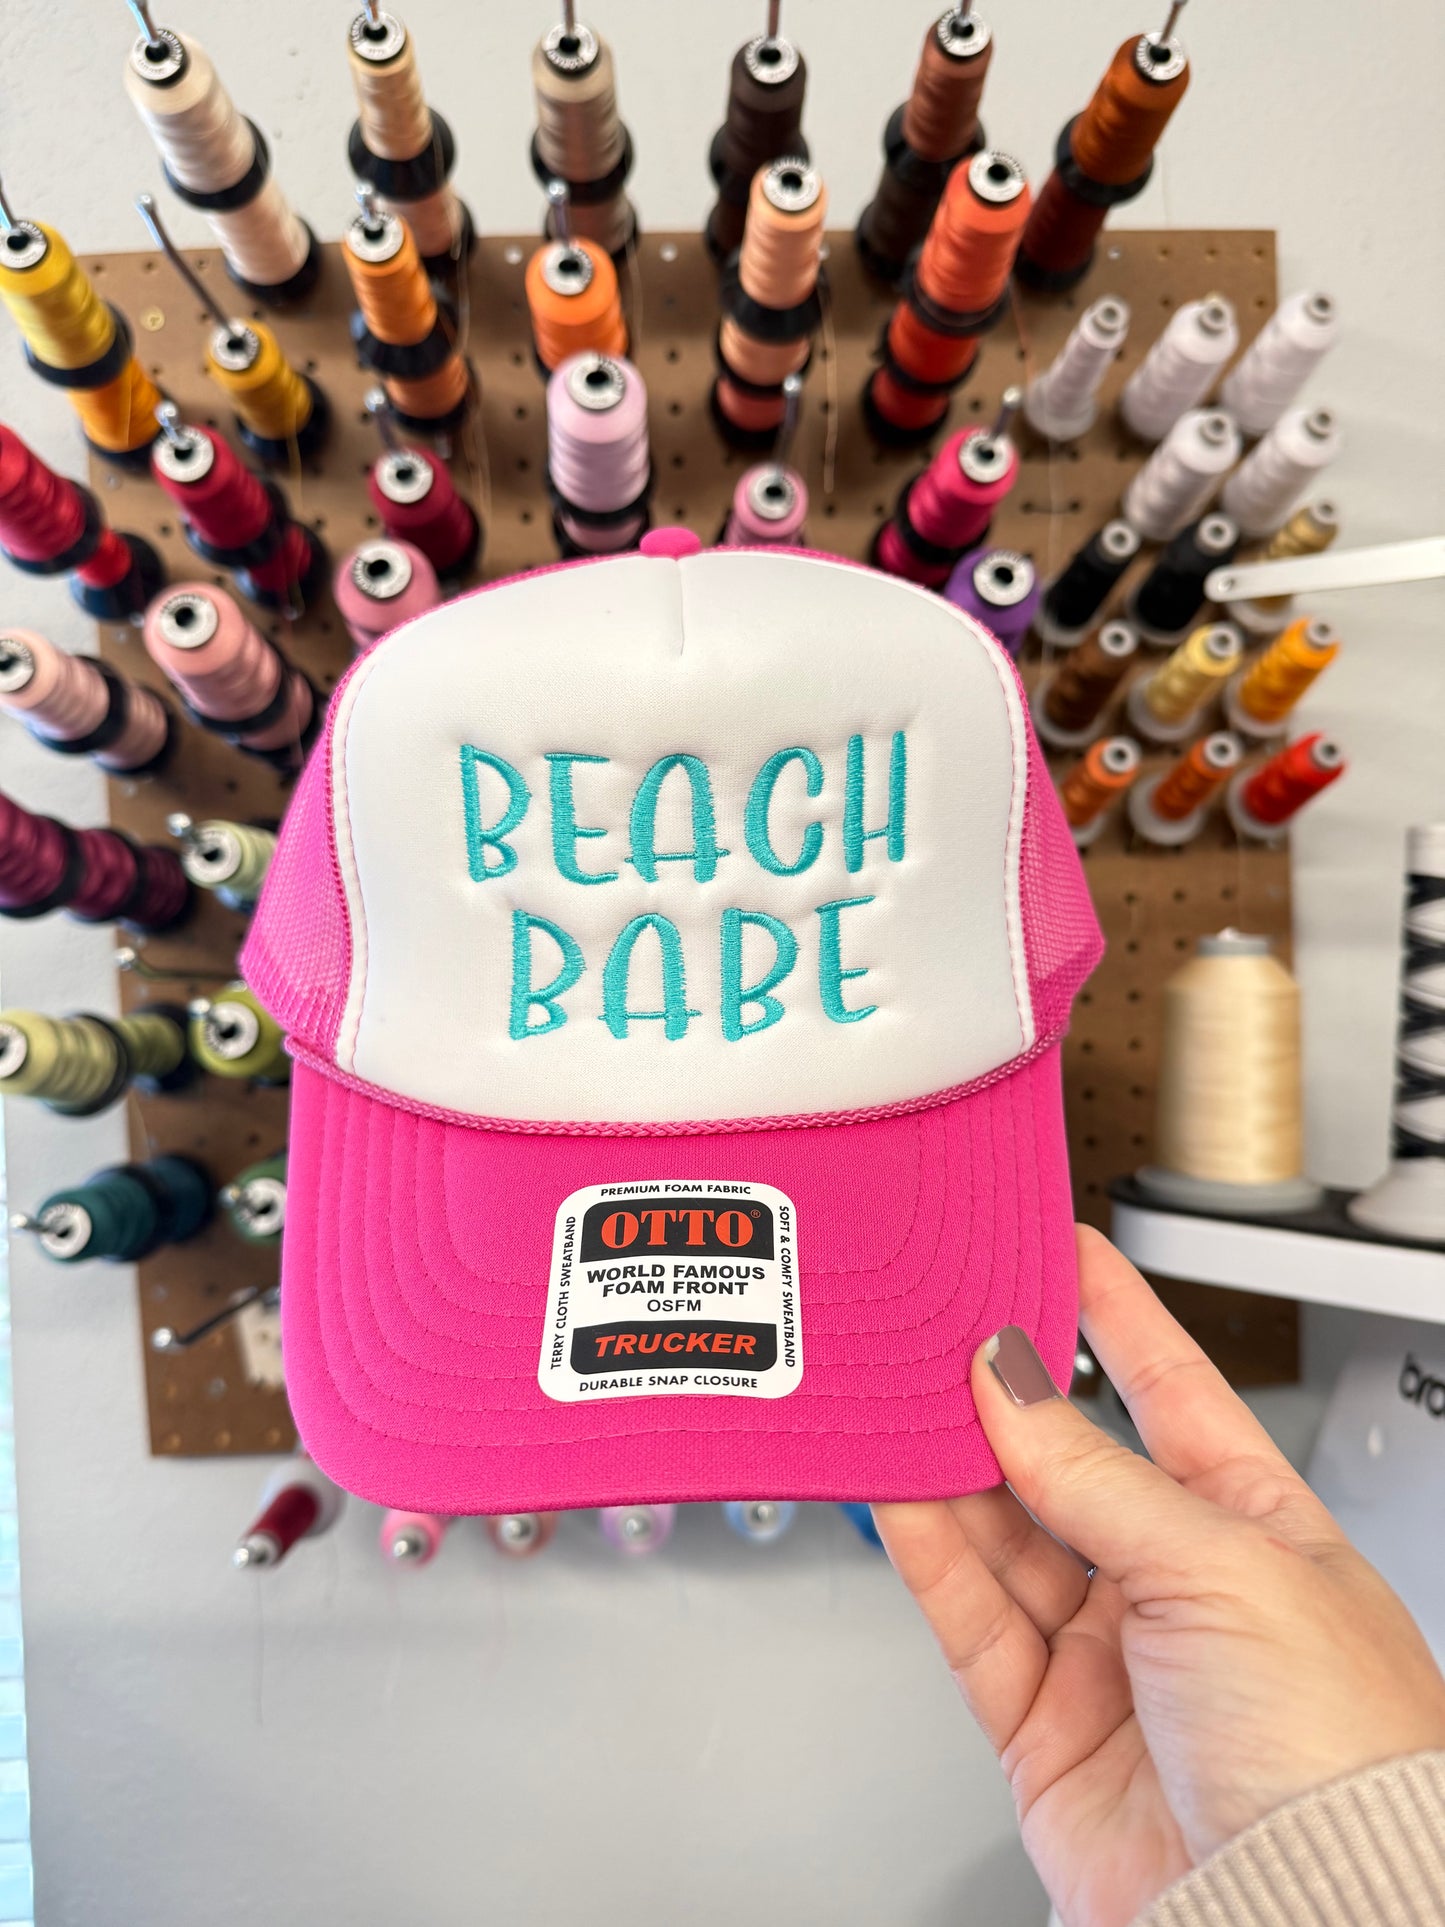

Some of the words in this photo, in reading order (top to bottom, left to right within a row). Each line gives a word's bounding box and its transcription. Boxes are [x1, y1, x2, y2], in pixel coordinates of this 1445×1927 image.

[460, 730, 907, 886] BEACH
[508, 895, 879, 1042] BABE
[600, 1184, 660, 1196] PREMIUM
[664, 1184, 703, 1192] FOAM
[707, 1184, 751, 1194] FABRIC
[779, 1205, 790, 1232] SOFT
[560, 1216, 576, 1287] SWEATBAND
[780, 1235, 791, 1244] &
[587, 1264, 665, 1283] WORLD
[673, 1265, 765, 1279] FAMOUS
[781, 1247, 793, 1288] COMFY
[603, 1281, 664, 1297] FOAM
[673, 1281, 748, 1295] FRONT
[556, 1291, 569, 1329] CLOTH
[647, 1299, 702, 1312] OSFM
[783, 1291, 796, 1368] SWEATBAND
[550, 1333, 565, 1370] TERRY
[595, 1332, 757, 1357] TRUCKER
[579, 1376, 643, 1392] DURABLE
[648, 1375, 689, 1386] SNAP
[694, 1375, 758, 1388] CLOSURE
